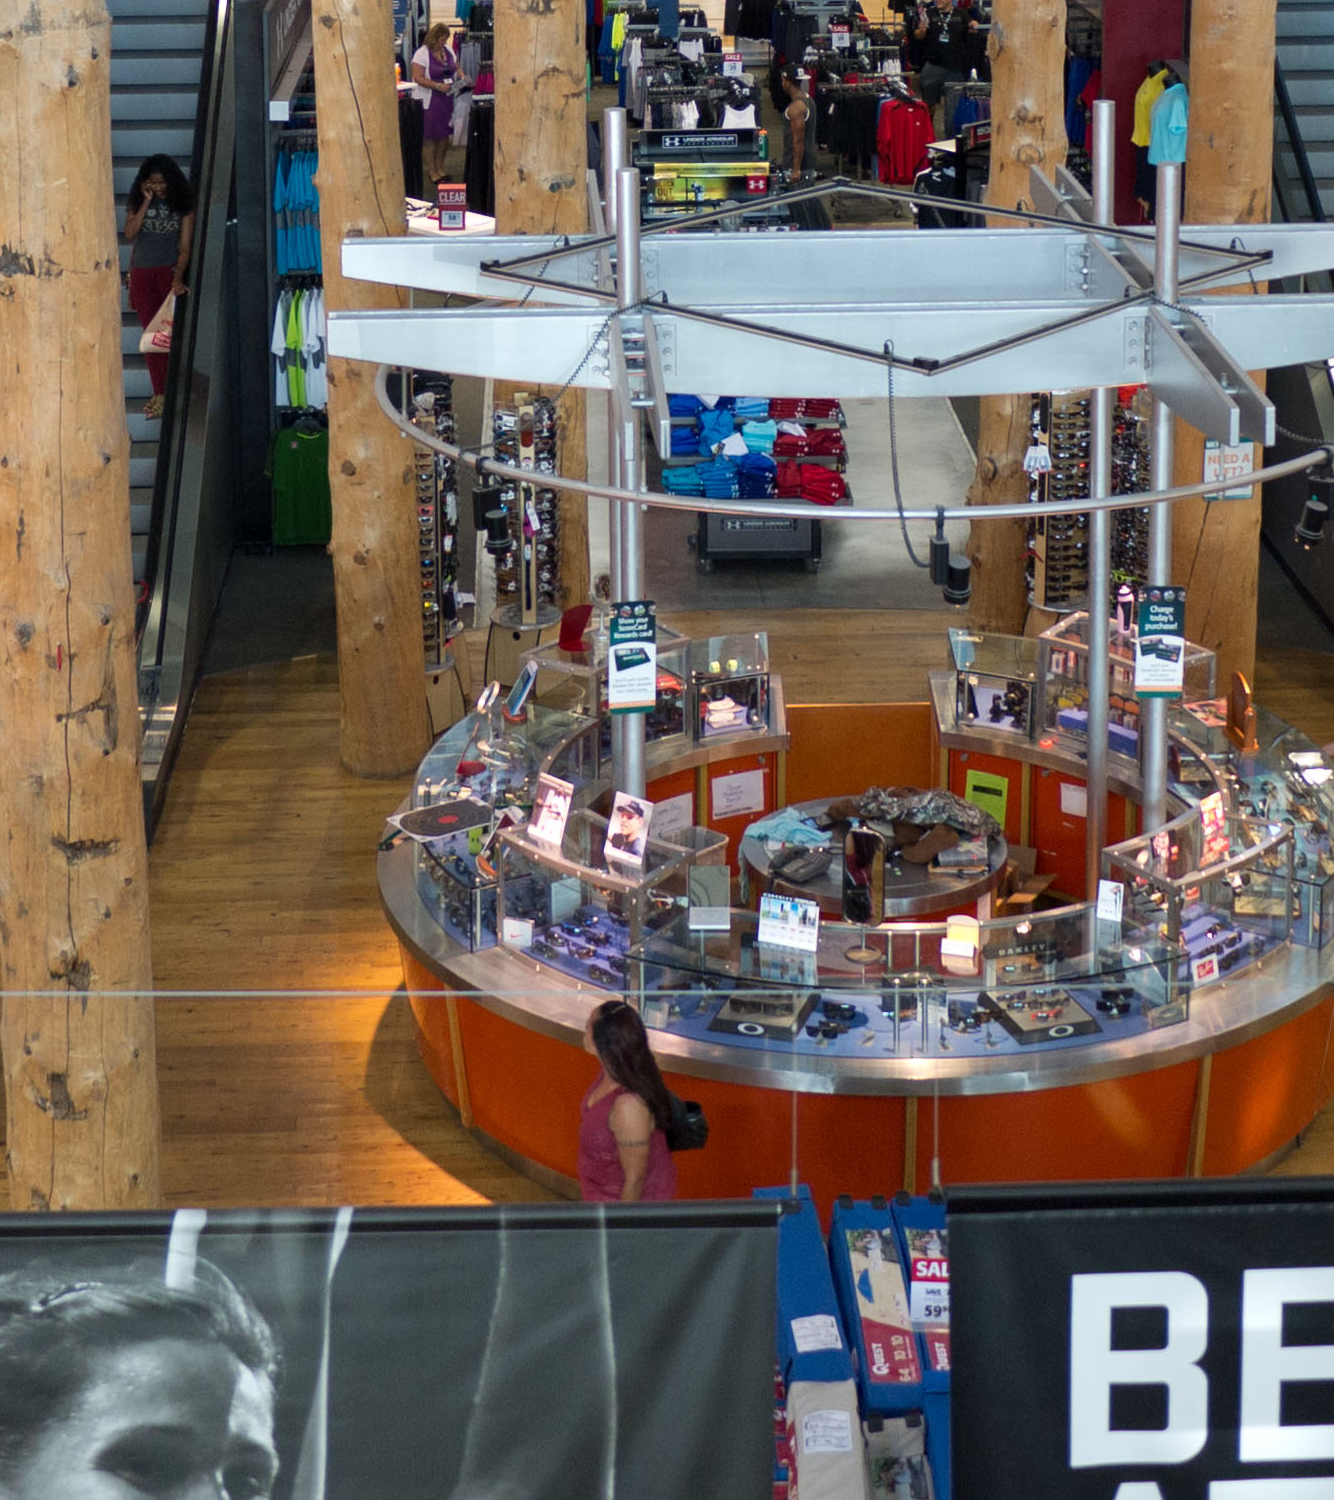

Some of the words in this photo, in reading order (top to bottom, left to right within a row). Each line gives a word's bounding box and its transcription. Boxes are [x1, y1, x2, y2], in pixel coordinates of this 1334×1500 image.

[439, 192, 466, 204] CLEAR
[1149, 604, 1174, 614] Charge
[998, 942, 1046, 956] OAKLEY
[917, 1260, 951, 1277] SAL
[871, 1342, 889, 1375] QUEST
